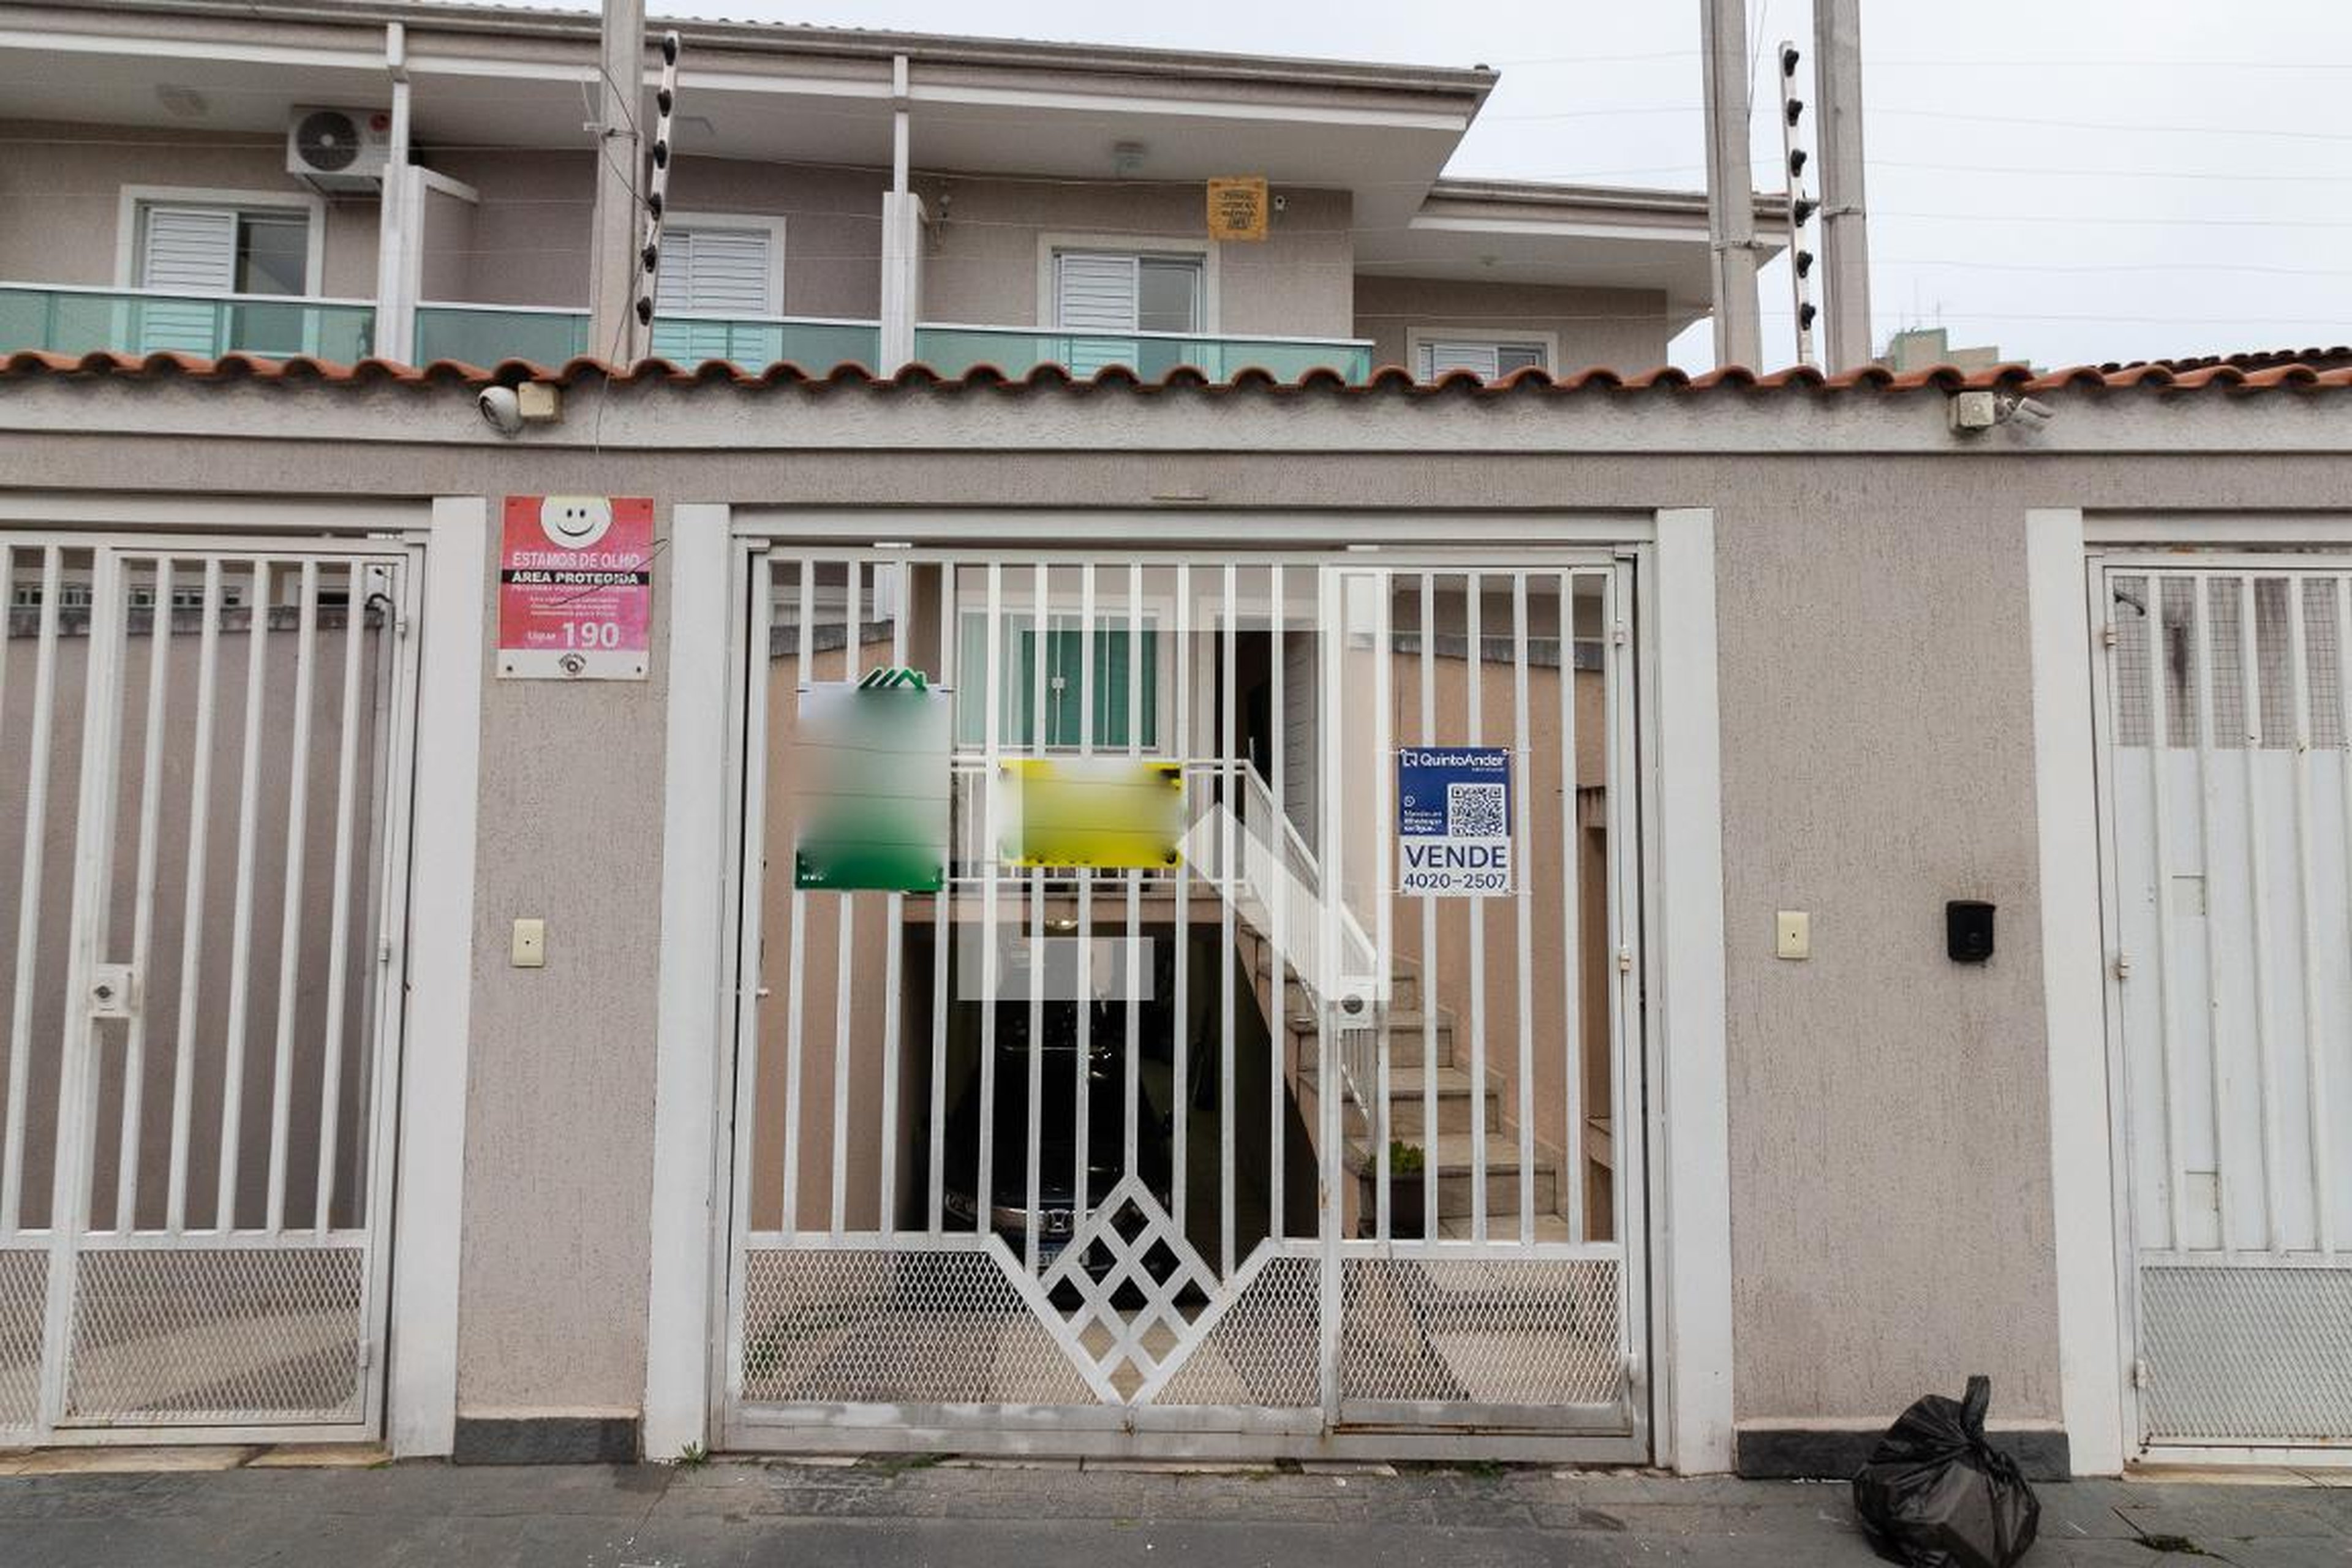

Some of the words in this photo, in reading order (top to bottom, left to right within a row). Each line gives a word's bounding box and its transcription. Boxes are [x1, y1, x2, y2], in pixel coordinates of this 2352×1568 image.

[512, 552, 576, 567] ESTAMOS
[579, 554, 598, 568] DE
[601, 553, 640, 568] OLHO
[555, 573, 638, 585] PROTEGIDA
[562, 622, 620, 648] 190
[1420, 753, 1506, 766] QuintoAndar
[1404, 845, 1507, 868] VENDE
[1404, 873, 1506, 889] 4020-2507
